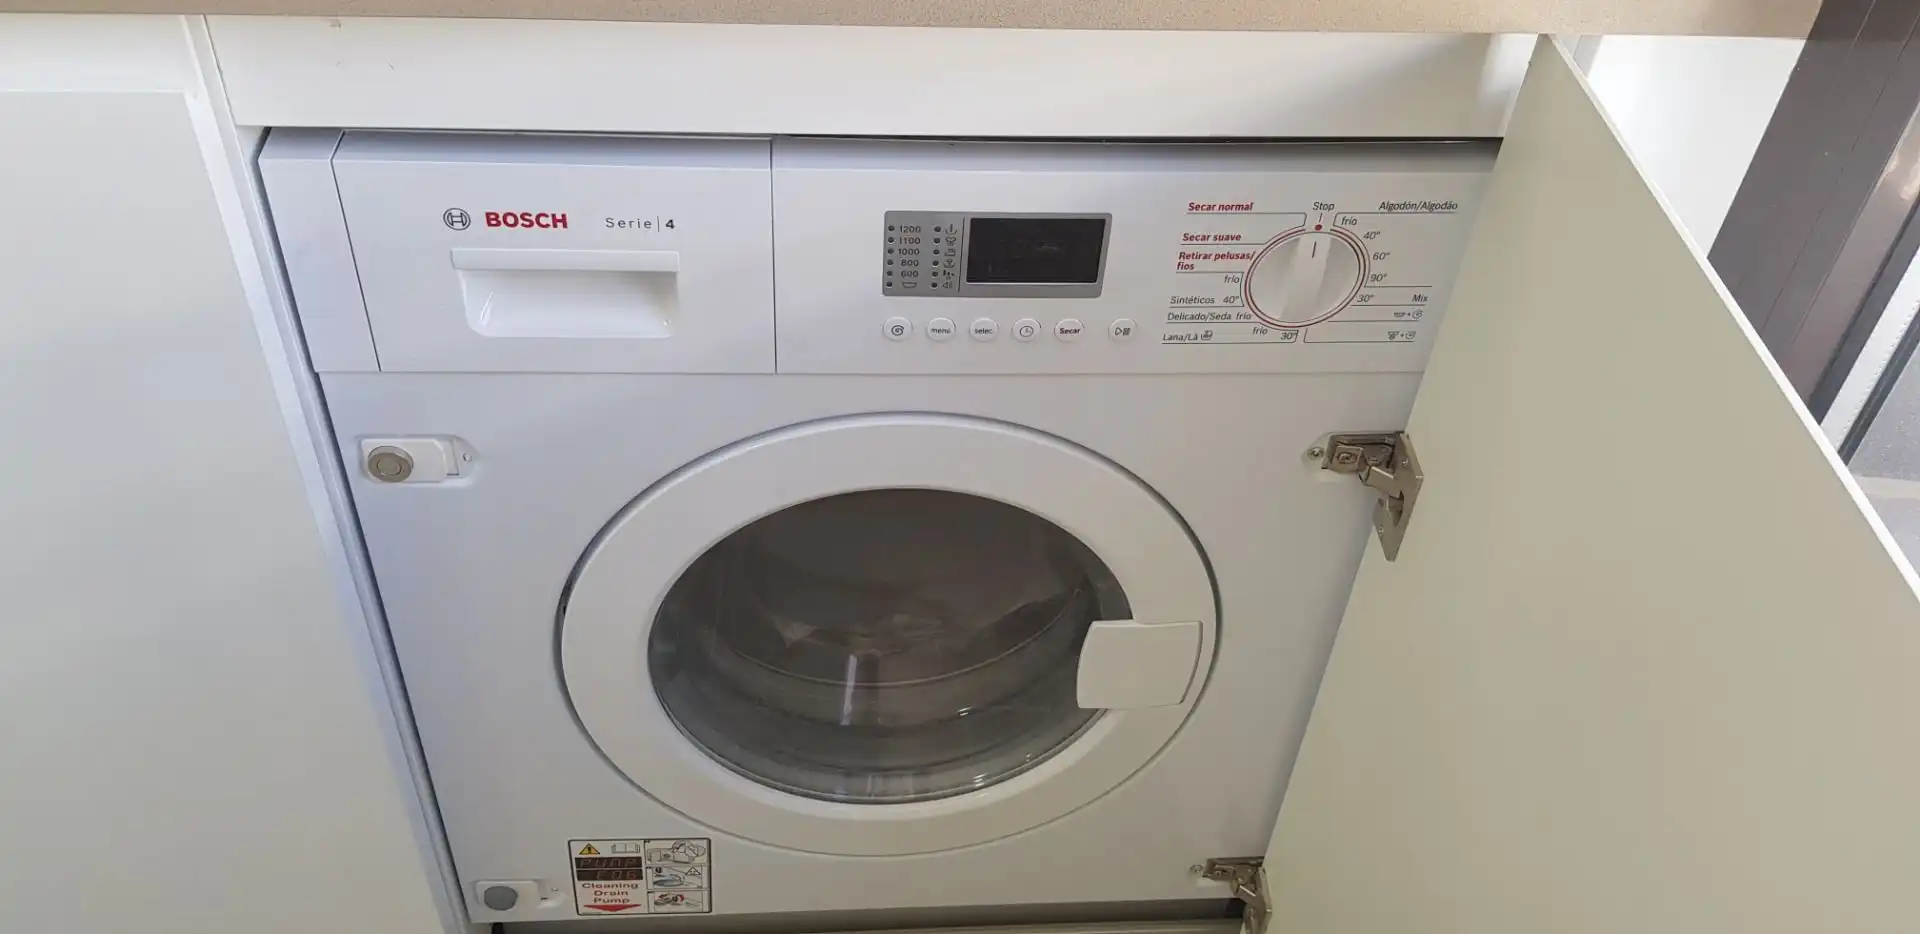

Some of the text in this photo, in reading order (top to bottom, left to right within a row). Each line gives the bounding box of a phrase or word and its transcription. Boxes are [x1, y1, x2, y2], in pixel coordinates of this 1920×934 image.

[1188, 202, 1254, 211] Secar normal
[1312, 201, 1335, 211] Stop
[485, 211, 568, 229] BOSCH
[605, 217, 675, 229] Serie 4
[900, 224, 921, 233] 1200
[900, 236, 921, 244] 1100
[1183, 233, 1211, 241] Secar
[899, 247, 920, 256] 1000
[1179, 251, 1255, 262] Retirar pelusas/
[901, 259, 919, 267] 800
[1177, 261, 1194, 270] fios
[901, 270, 919, 278] 600
[1170, 296, 1215, 305] Sintéticos
[1412, 294, 1427, 302] Mix
[1168, 312, 1232, 321] Delicado/Seda
